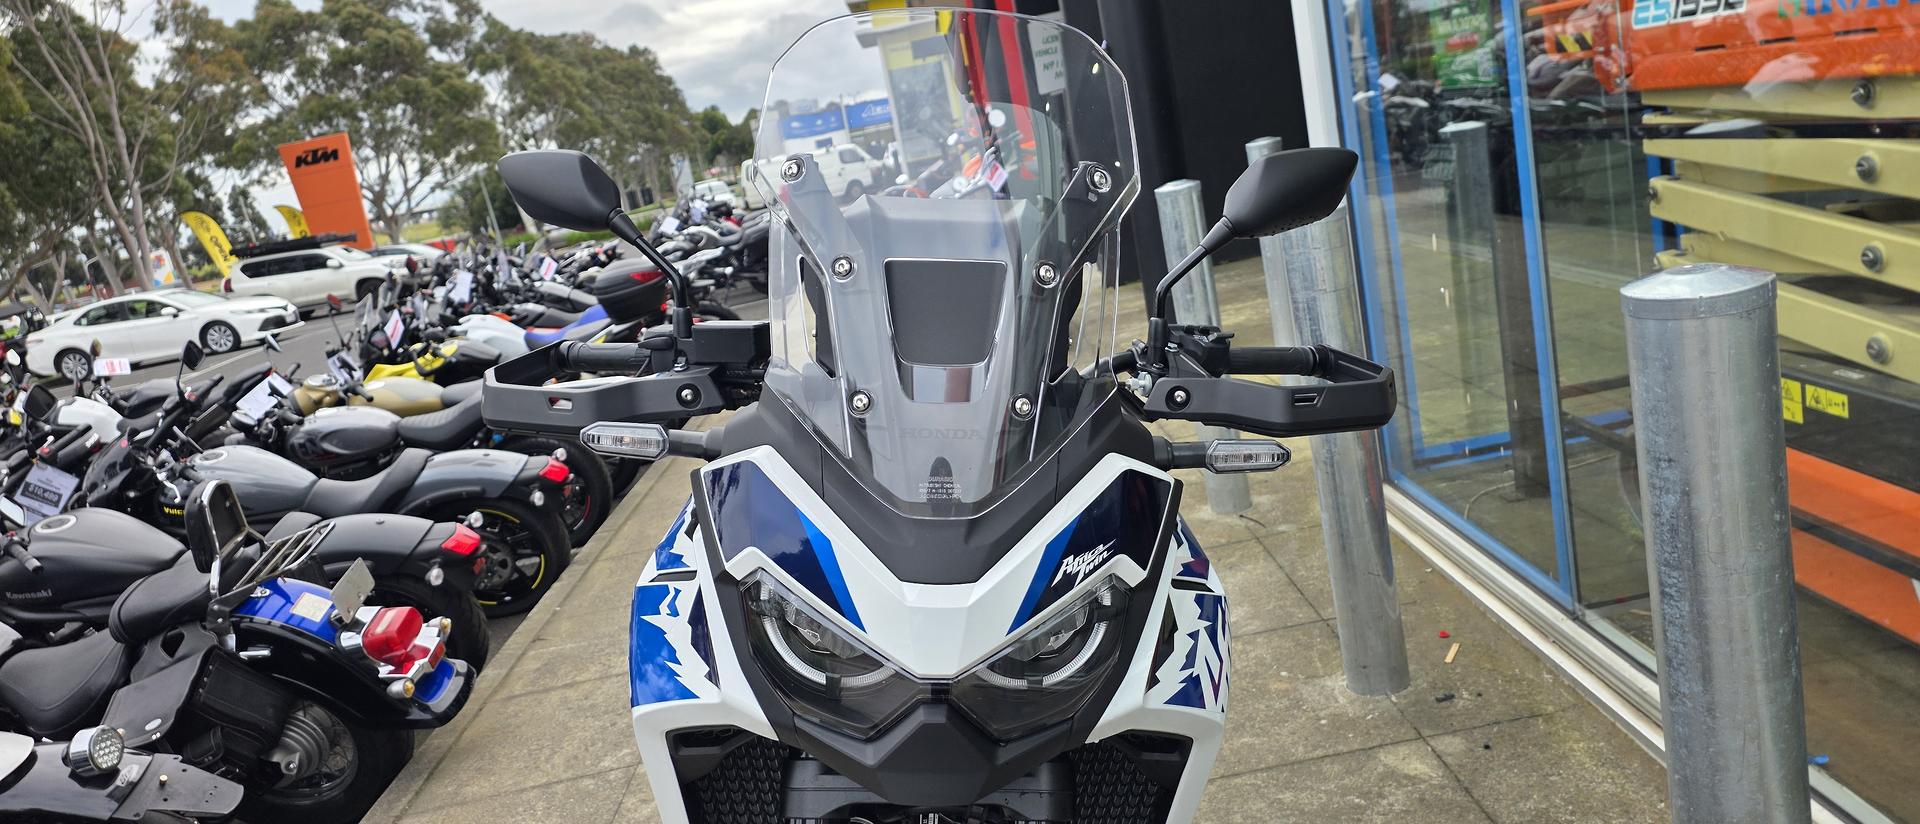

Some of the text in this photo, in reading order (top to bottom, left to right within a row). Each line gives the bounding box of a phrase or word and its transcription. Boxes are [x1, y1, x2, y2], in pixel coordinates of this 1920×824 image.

[295, 148, 338, 168] KTM
[898, 427, 985, 440] HONDA
[163, 505, 185, 517] Vulc
[1050, 538, 1117, 588] Africa
[1074, 549, 1115, 588] Twin
